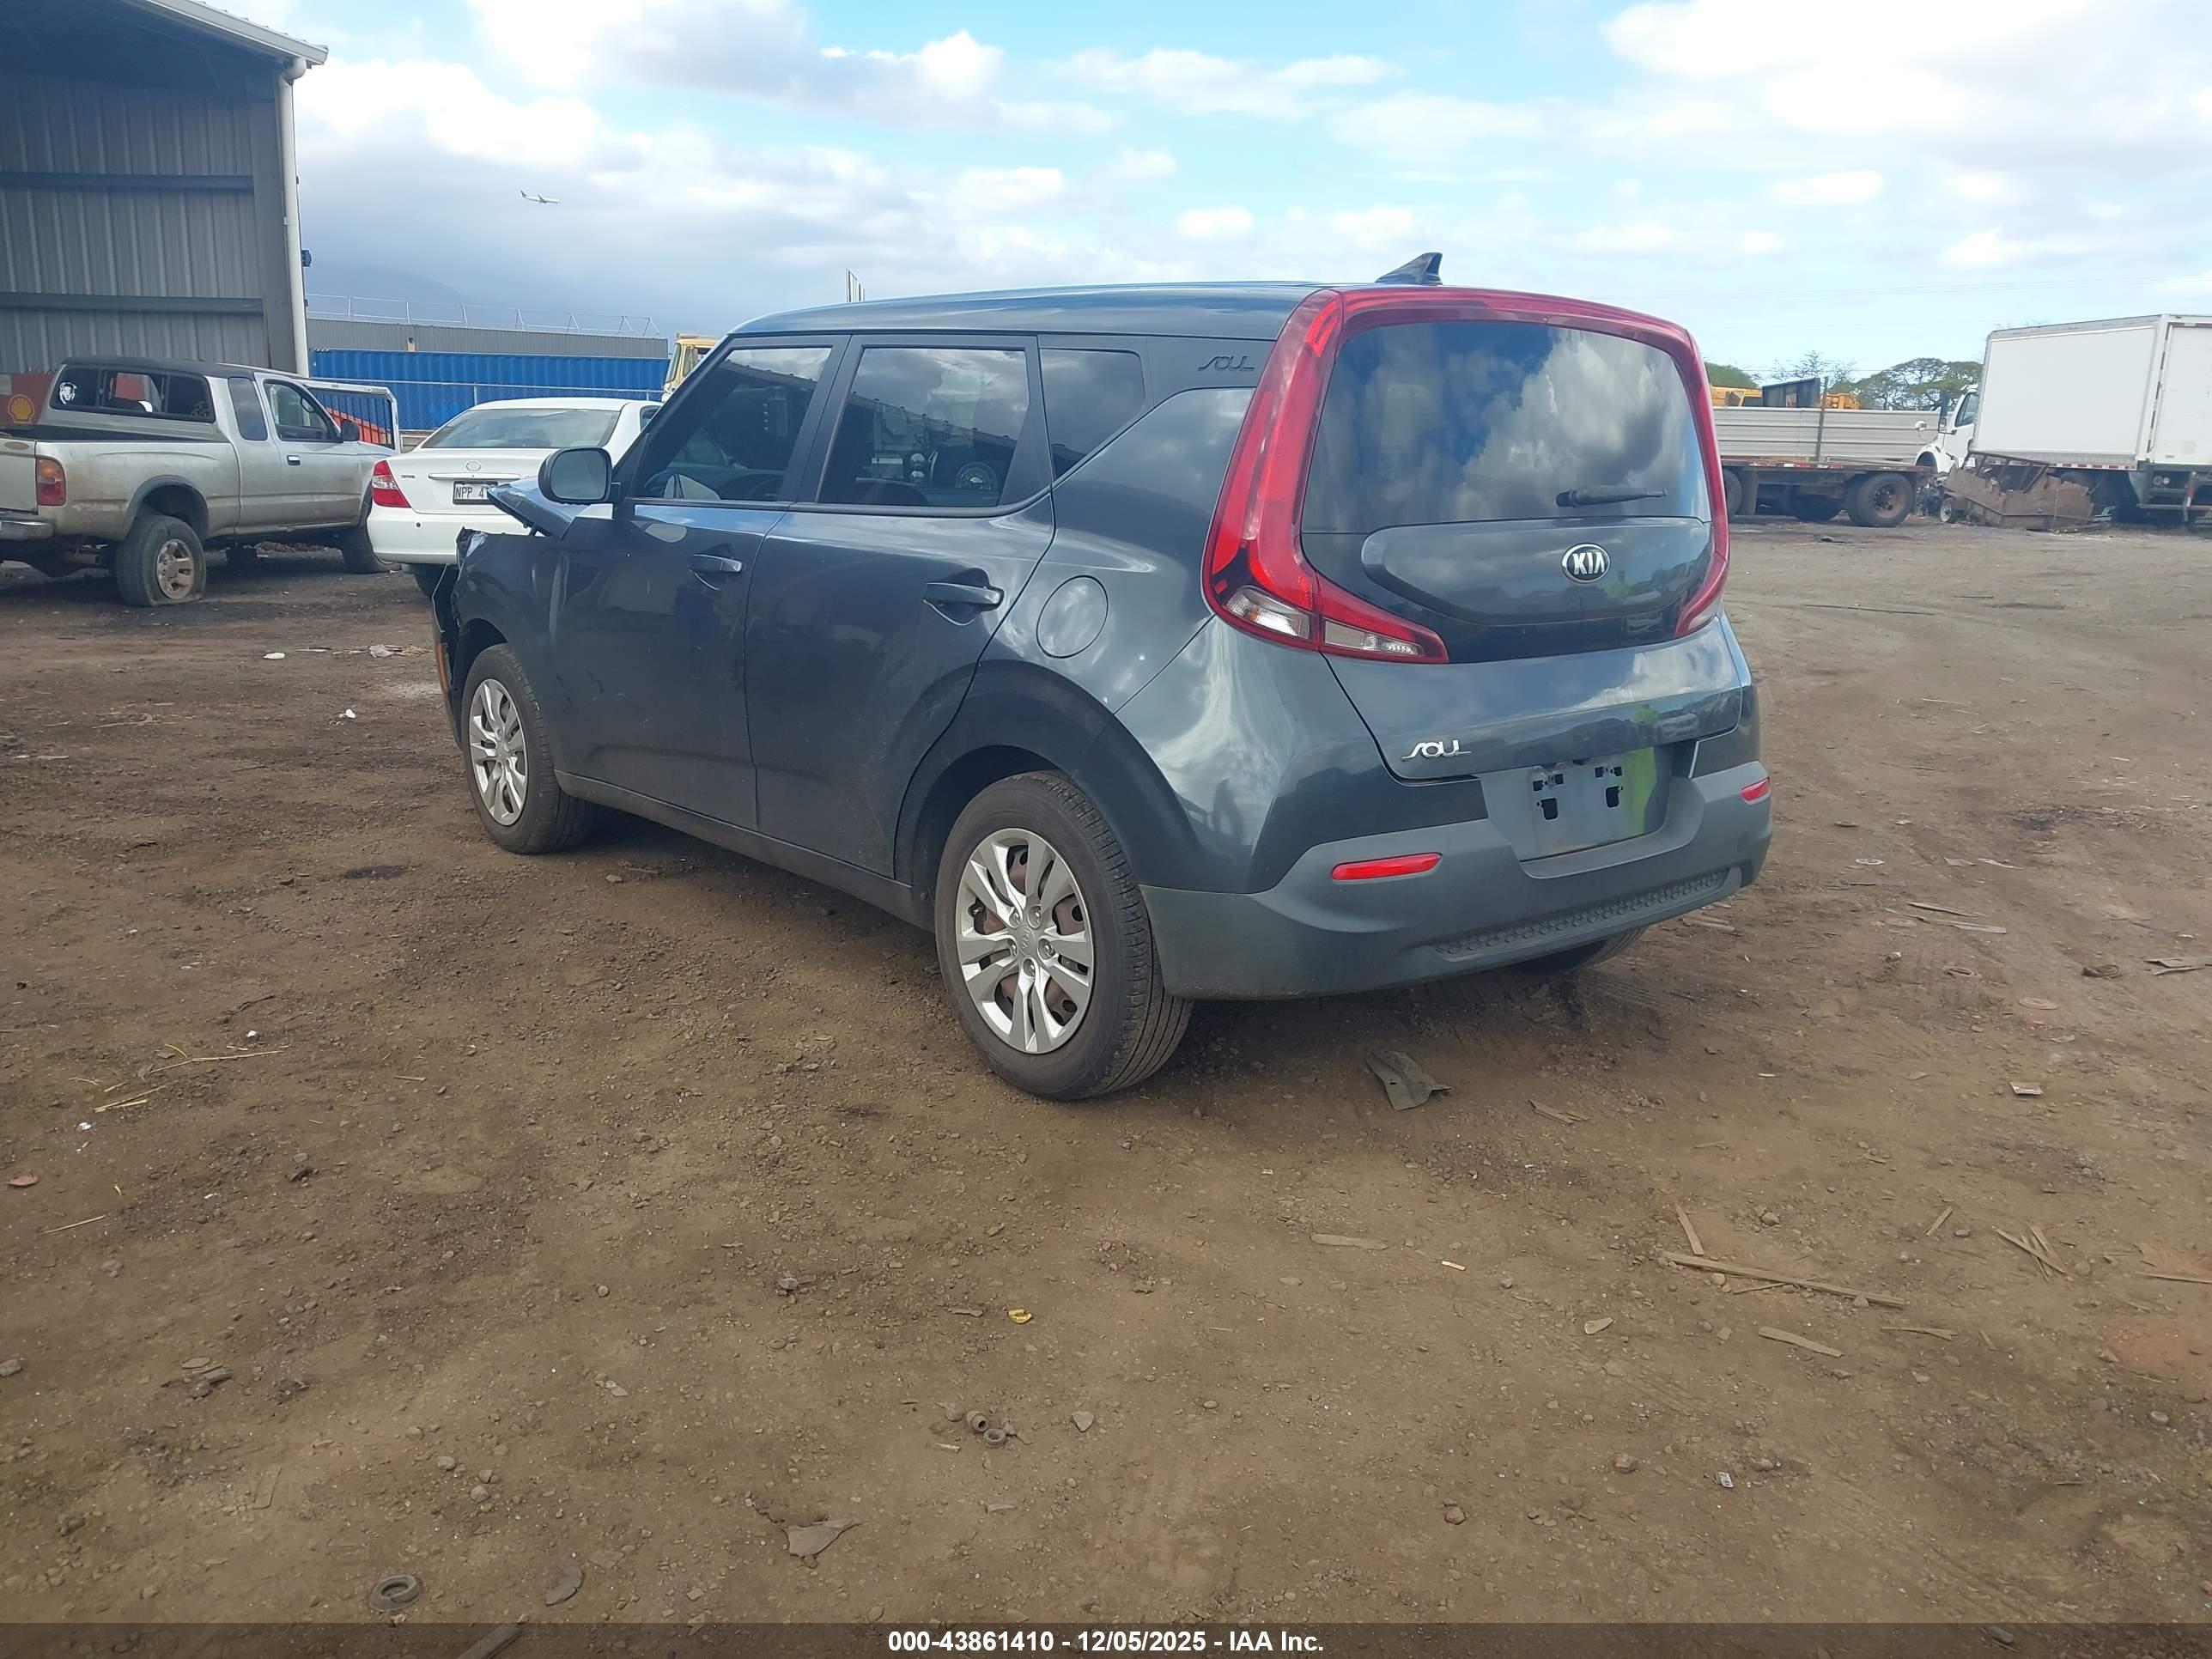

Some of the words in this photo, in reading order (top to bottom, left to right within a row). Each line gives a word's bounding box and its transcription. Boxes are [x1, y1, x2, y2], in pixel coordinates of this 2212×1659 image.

[1198, 356, 1256, 371] SOUL
[455, 486, 473, 499] NPP
[1572, 551, 1606, 575] KIA
[1401, 739, 1472, 762] SOUL
